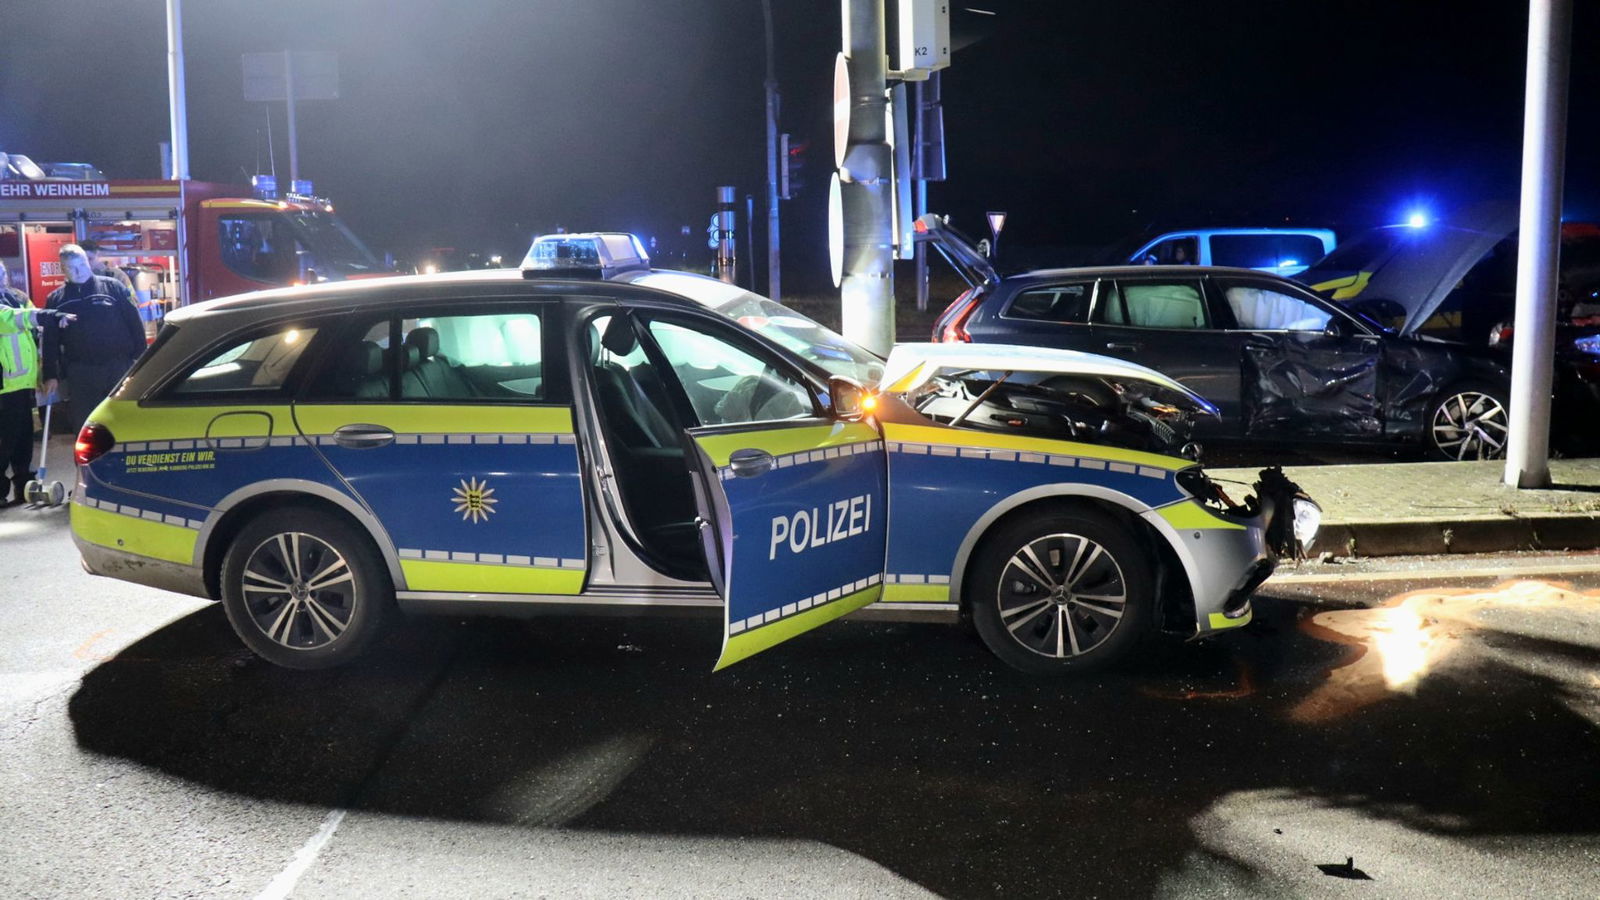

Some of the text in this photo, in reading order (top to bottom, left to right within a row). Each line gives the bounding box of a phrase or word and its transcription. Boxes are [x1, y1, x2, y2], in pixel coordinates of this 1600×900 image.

[914, 47, 928, 56] K2
[34, 183, 109, 196] WEINHEIM
[126, 455, 136, 465] DU
[138, 453, 180, 464] VERDIENST
[181, 452, 196, 462] EIN
[769, 494, 871, 560] POLIZEI
